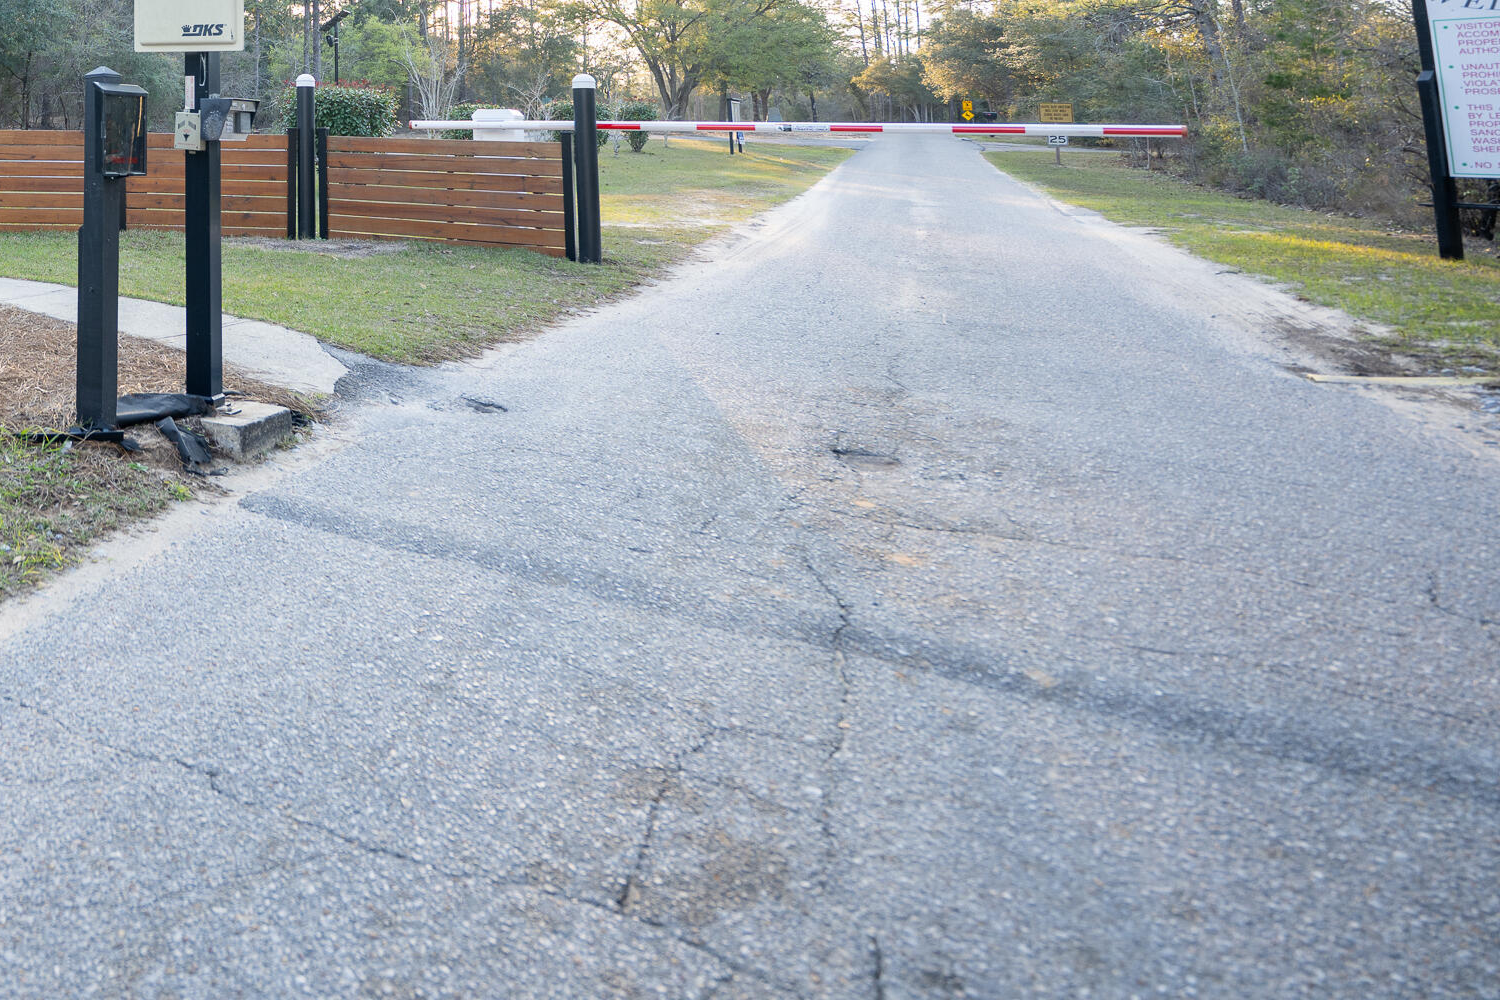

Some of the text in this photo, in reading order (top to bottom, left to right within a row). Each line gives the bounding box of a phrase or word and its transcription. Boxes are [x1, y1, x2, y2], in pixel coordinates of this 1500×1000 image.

[182, 24, 224, 36] DKS
[1458, 38, 1500, 47] PROPE
[1462, 71, 1500, 79] PROHI
[1468, 112, 1483, 120] BY
[1049, 135, 1066, 144] 25
